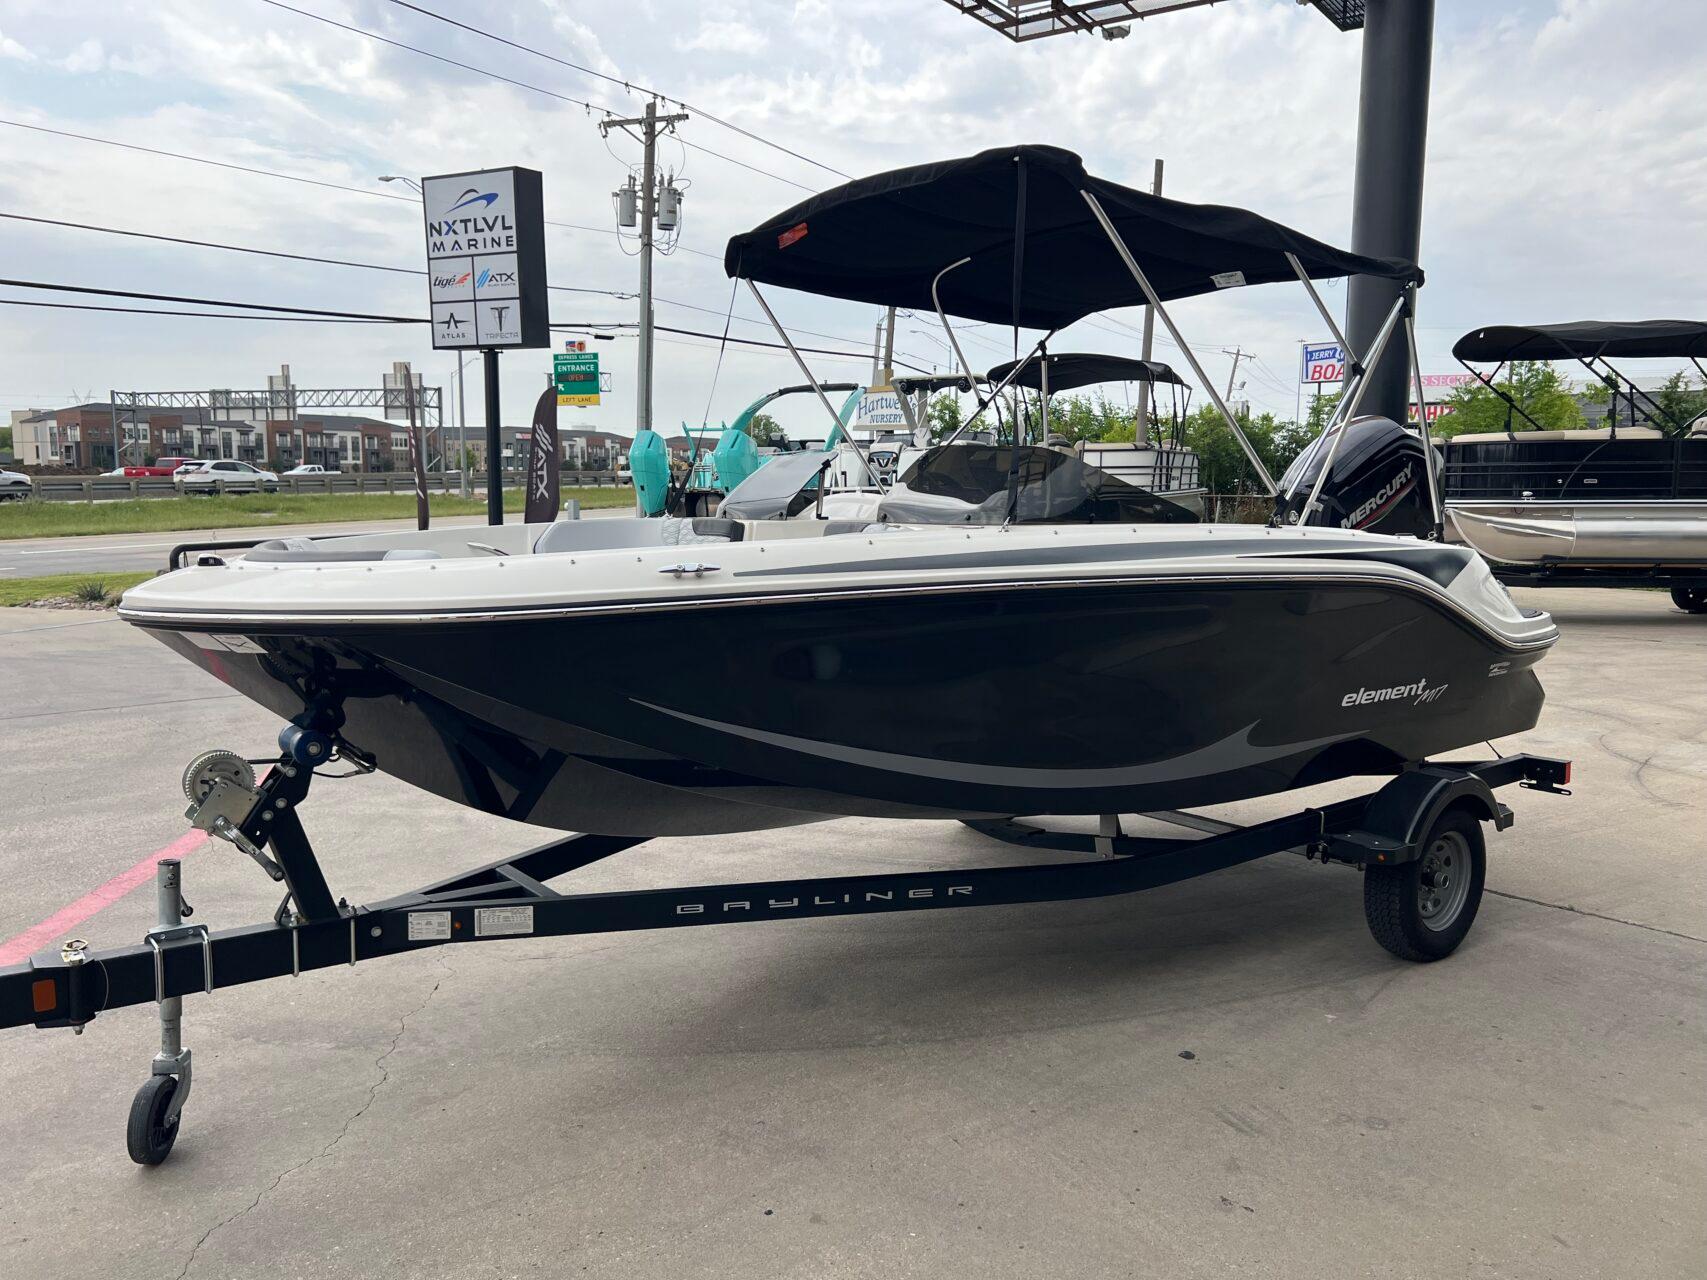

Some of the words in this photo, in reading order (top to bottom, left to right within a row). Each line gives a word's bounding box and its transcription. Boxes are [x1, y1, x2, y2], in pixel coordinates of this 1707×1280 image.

[429, 215, 513, 237] NXTLVL
[432, 236, 514, 252] MARINE
[433, 274, 456, 288] tigé
[488, 272, 515, 283] ATX
[1311, 350, 1334, 360] JERRY
[557, 364, 595, 372] ENTRANCE
[1311, 363, 1344, 380] BOA
[870, 413, 903, 424] NURSERY
[537, 447, 549, 500] ATX
[1340, 461, 1413, 529] MERCURY
[1341, 678, 1427, 707] element
[676, 885, 973, 915] BAYLINER
